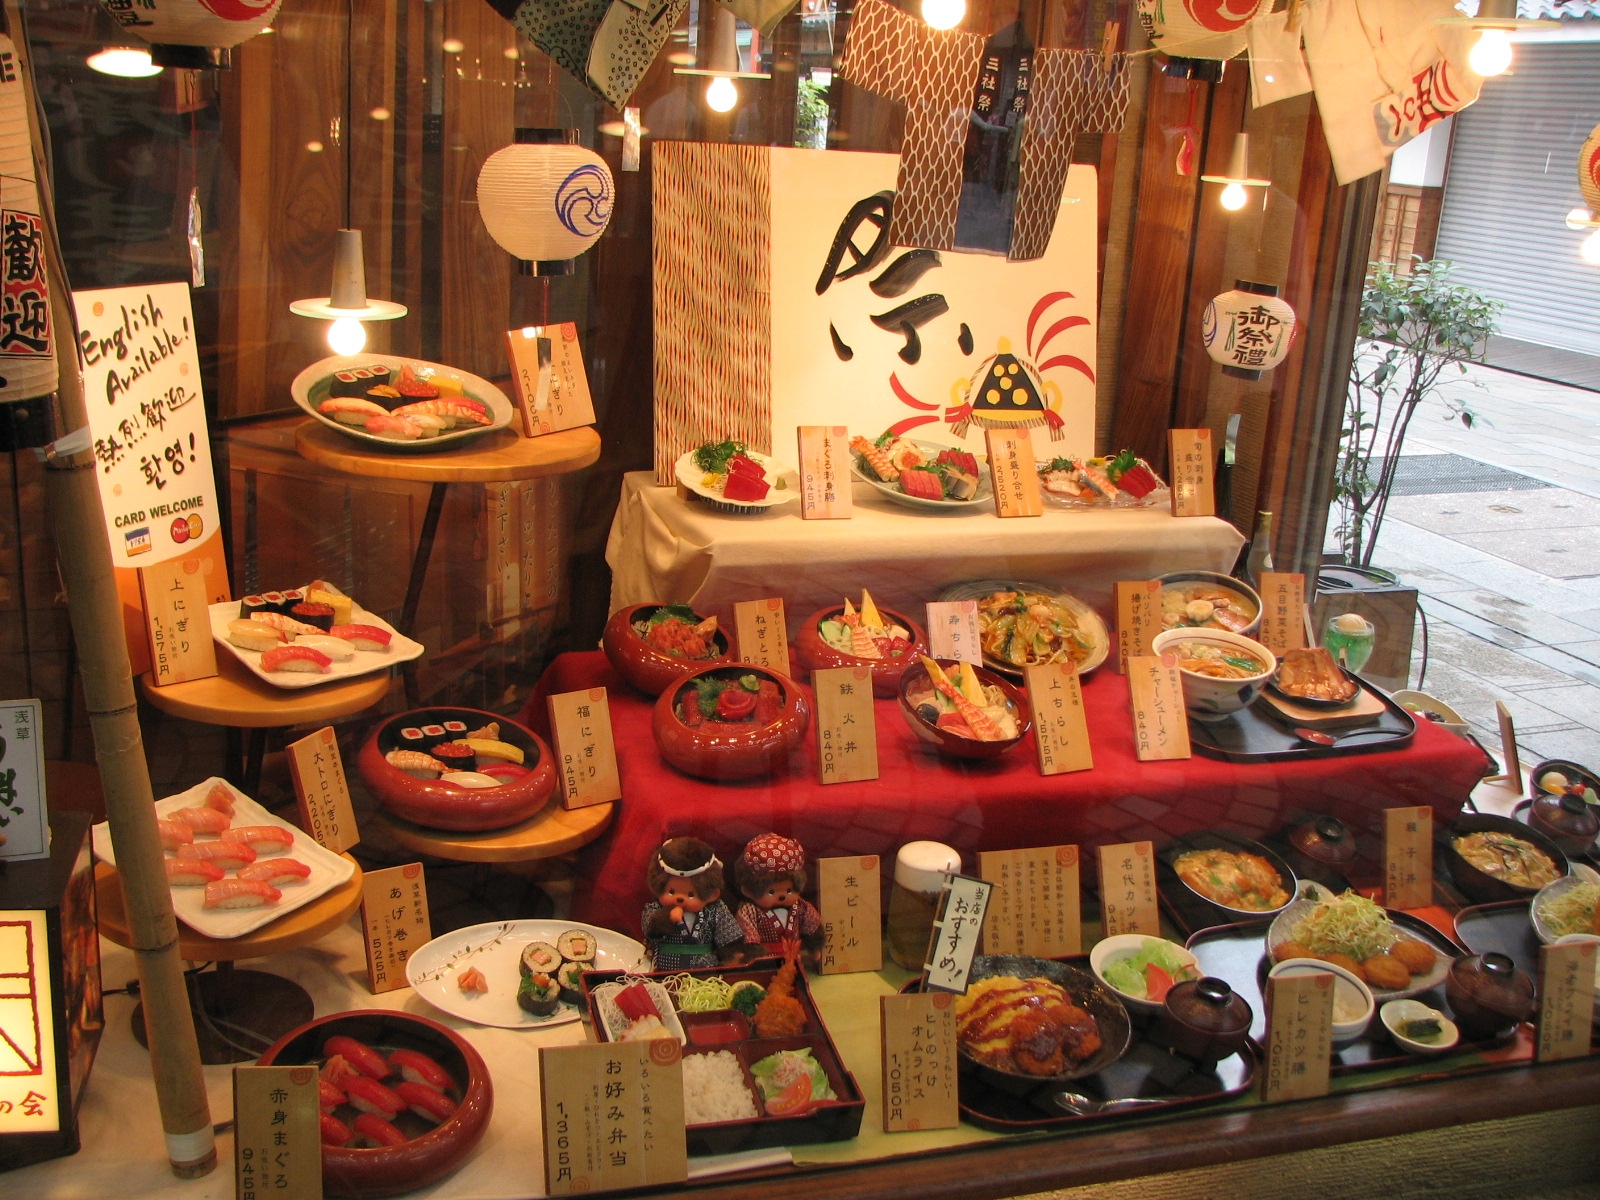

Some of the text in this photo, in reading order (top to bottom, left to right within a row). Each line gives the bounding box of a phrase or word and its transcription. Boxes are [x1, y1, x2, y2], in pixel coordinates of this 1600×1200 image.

[977, 57, 999, 112] 三社祭
[1013, 58, 1028, 113] 三社祭
[1, 215, 48, 352] 歓迎
[80, 294, 164, 365] English
[105, 316, 190, 405] Available!
[140, 432, 196, 490] 환영!
[823, 438, 836, 502] まぐろ刺身膳
[1006, 440, 1024, 500] 刺身盛り合せ
[114, 495, 204, 528] CARD WELCOME
[130, 535, 146, 548] VISA
[170, 578, 190, 653] 上にぎり
[755, 615, 769, 667] ねぎとろ
[14, 710, 30, 741] 浅草
[840, 683, 857, 753] 鉄火丼
[1049, 678, 1069, 746] 上ちらし
[1138, 711, 1149, 750] 840円
[1149, 667, 1167, 746] チャーシューメン
[564, 754, 579, 798] 945円
[576, 705, 596, 778] 福にぎり
[823, 730, 834, 773] 840円
[313, 751, 339, 837] 大トロにぎり
[389, 887, 408, 962] あげ巻き
[844, 875, 859, 947] 生ビール
[969, 886, 985, 926] 当店の
[1121, 858, 1139, 933] 名代カツ丼
[373, 938, 387, 985] 525円
[823, 922, 835, 966] 577円
[939, 897, 969, 982] おすすめ!
[912, 1025, 925, 1099] オムライス
[925, 1013, 938, 1087] ヒレのっけ
[269, 1088, 290, 1189] 赤身まぐろ
[605, 1060, 628, 1167] お好み弁当
[639, 1058, 654, 1151] いろいろ食べたい
[242, 1148, 255, 1200] 945円
